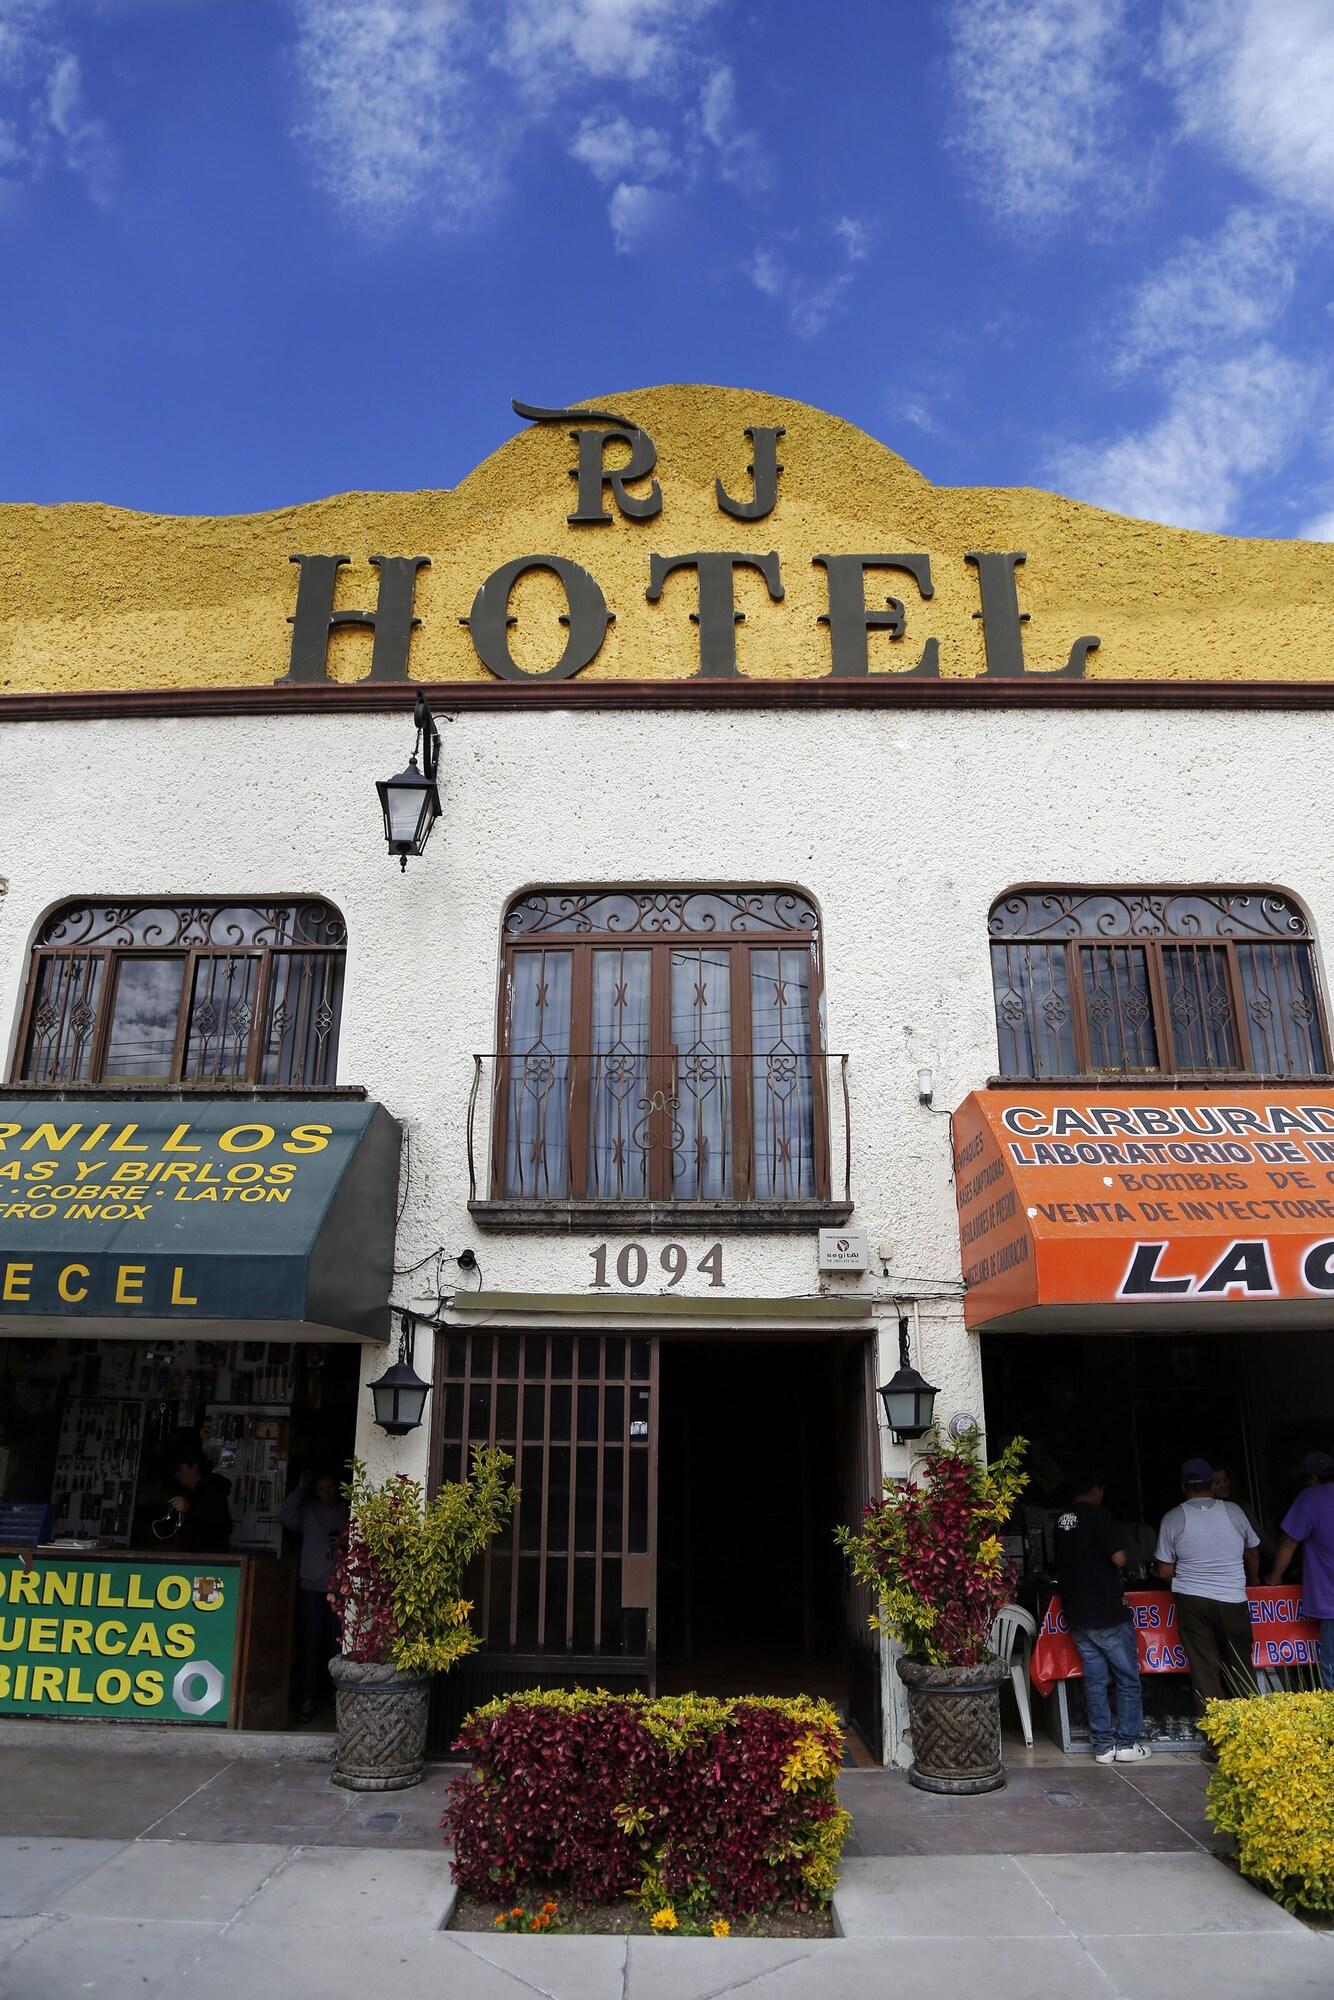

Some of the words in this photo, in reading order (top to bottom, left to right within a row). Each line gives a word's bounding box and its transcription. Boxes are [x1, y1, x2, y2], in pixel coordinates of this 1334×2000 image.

[274, 552, 1101, 685] HOTEL
[1007, 1141, 1256, 1166] LABORATORIO
[1251, 1141, 1310, 1164] DE
[75, 1161, 108, 1181] Y
[111, 1162, 297, 1184] BIRLOS
[1118, 1173, 1248, 1192] BOMBAS
[1266, 1171, 1316, 1190] DE
[26, 1184, 150, 1200] COBRE
[174, 1184, 292, 1203] LATÓN
[0, 1203, 57, 1219] RO
[63, 1204, 153, 1220] INOX
[1036, 1202, 1137, 1223] VENTA
[1138, 1202, 1179, 1222] DE
[589, 1243, 725, 1288] 1094
[1115, 1239, 1280, 1298] LA
[3, 1263, 198, 1306] ECEL
[0, 1570, 224, 1611] RNILLO
[0, 1617, 196, 1658] UERCAS
